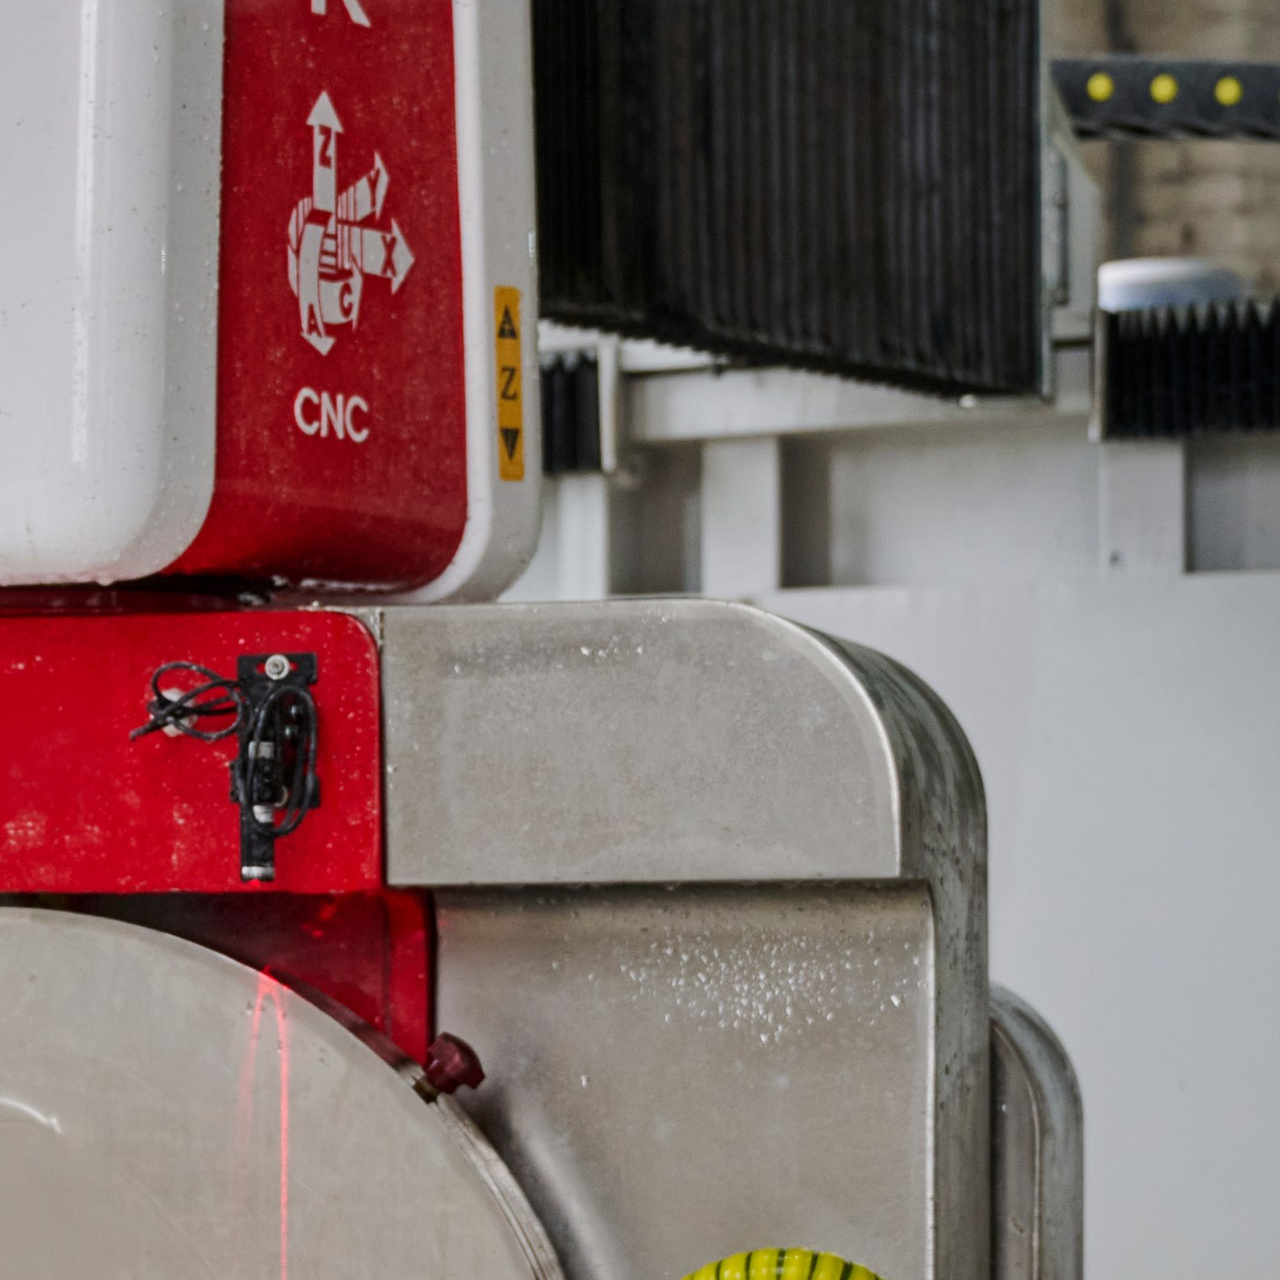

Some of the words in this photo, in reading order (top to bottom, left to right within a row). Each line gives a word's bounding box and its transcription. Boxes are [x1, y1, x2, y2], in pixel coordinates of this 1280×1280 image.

[318, 124, 332, 169] Z
[381, 234, 397, 278] X
[339, 282, 353, 319] C
[501, 366, 518, 401] Z
[294, 387, 370, 442] CNC
